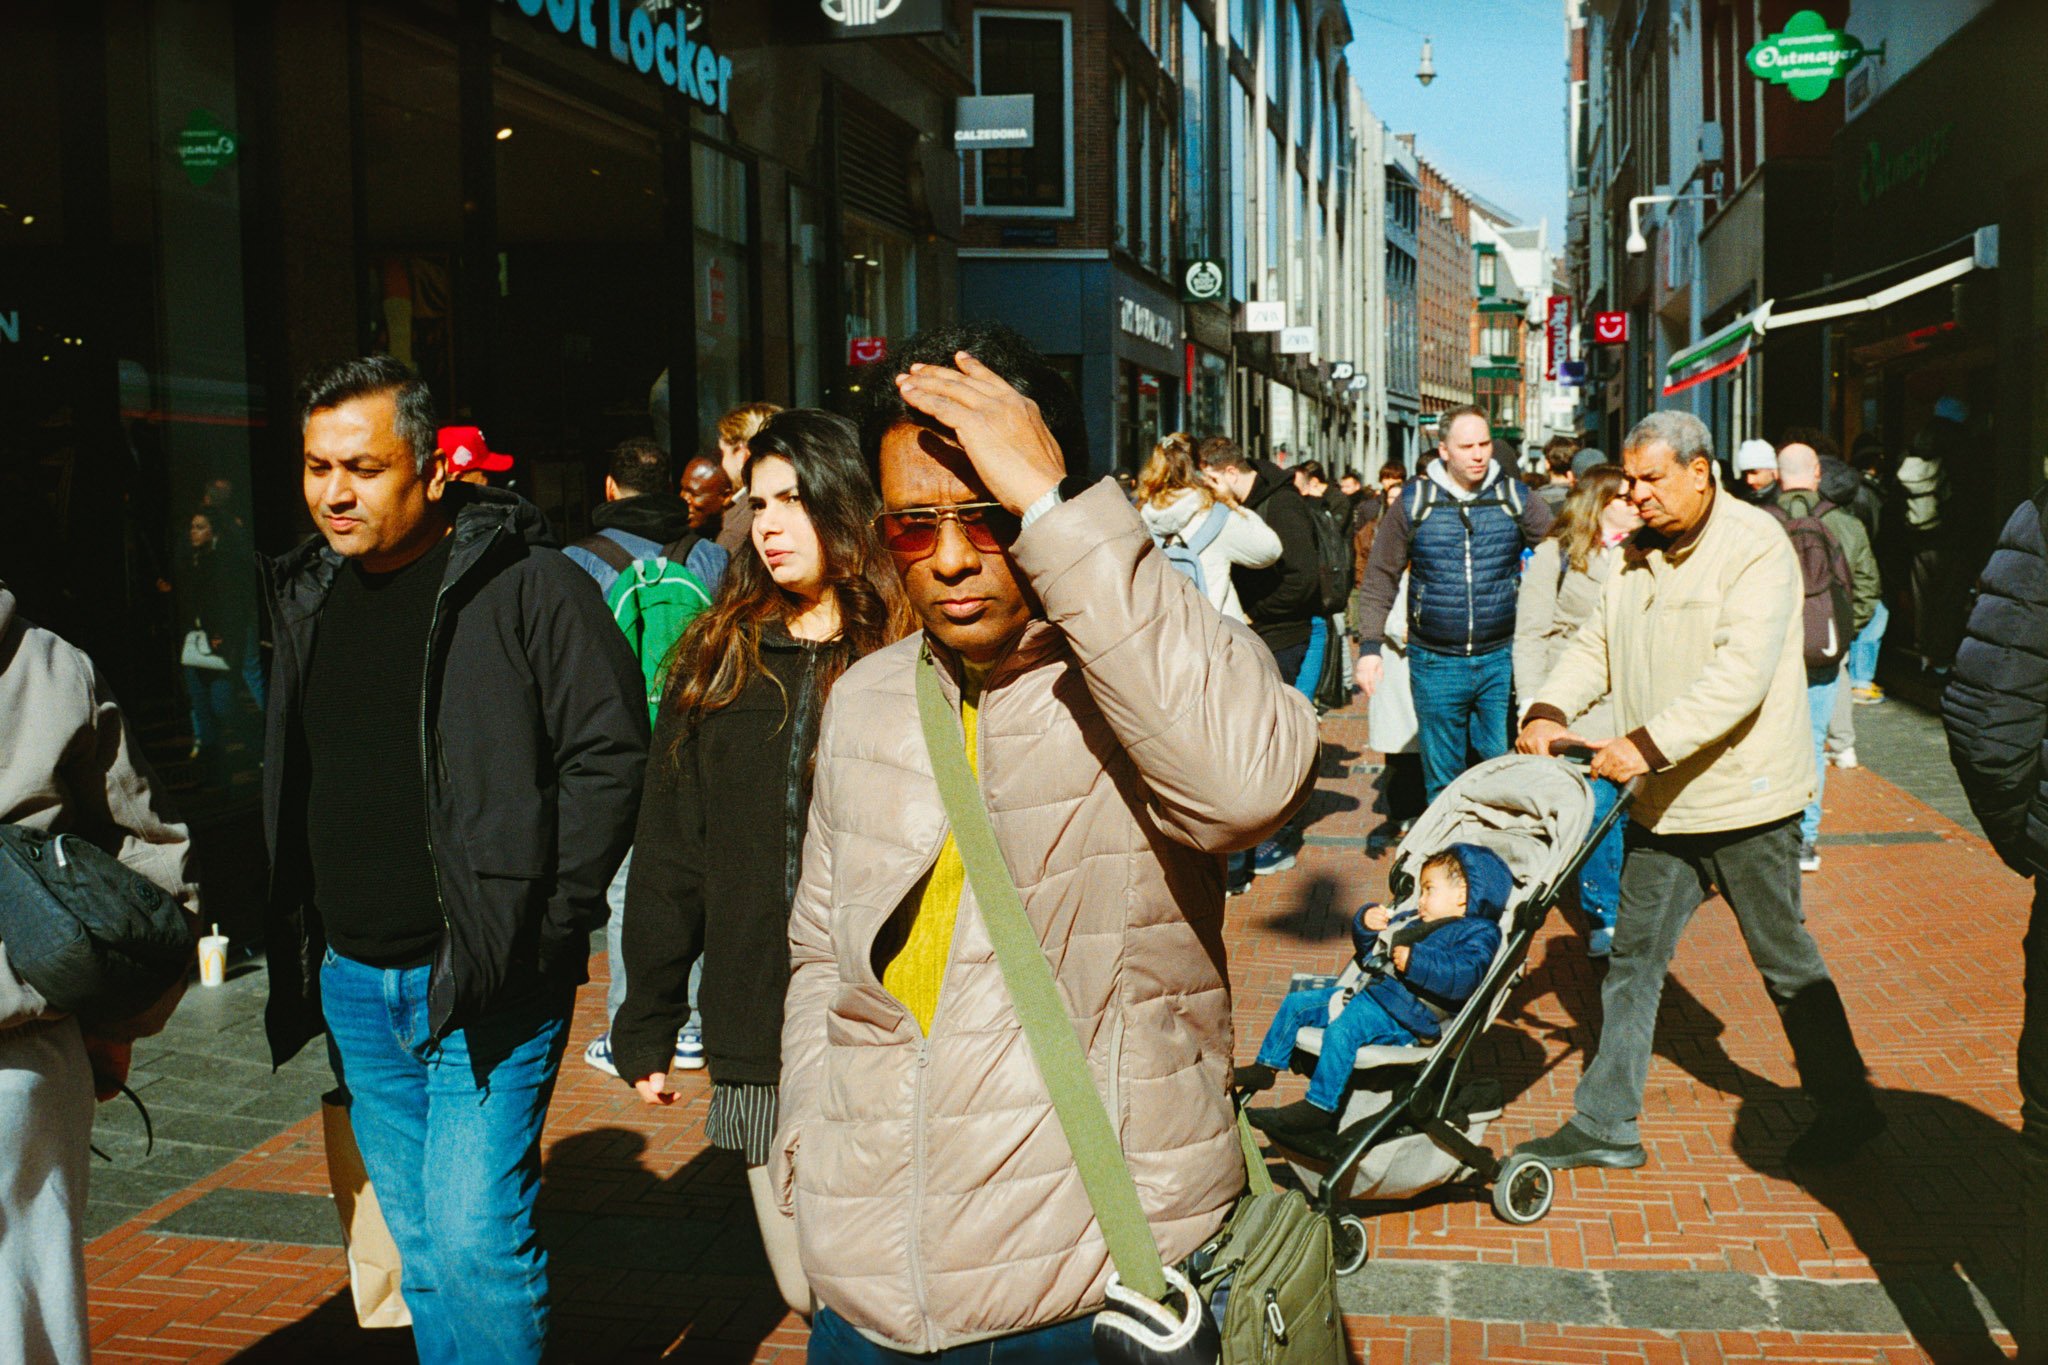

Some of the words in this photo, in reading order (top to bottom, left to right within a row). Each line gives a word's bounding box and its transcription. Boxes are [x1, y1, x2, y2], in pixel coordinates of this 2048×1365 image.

[608, 0, 733, 115] Locker
[953, 128, 1028, 141] CALZEDONIA
[1331, 364, 1353, 379] JD
